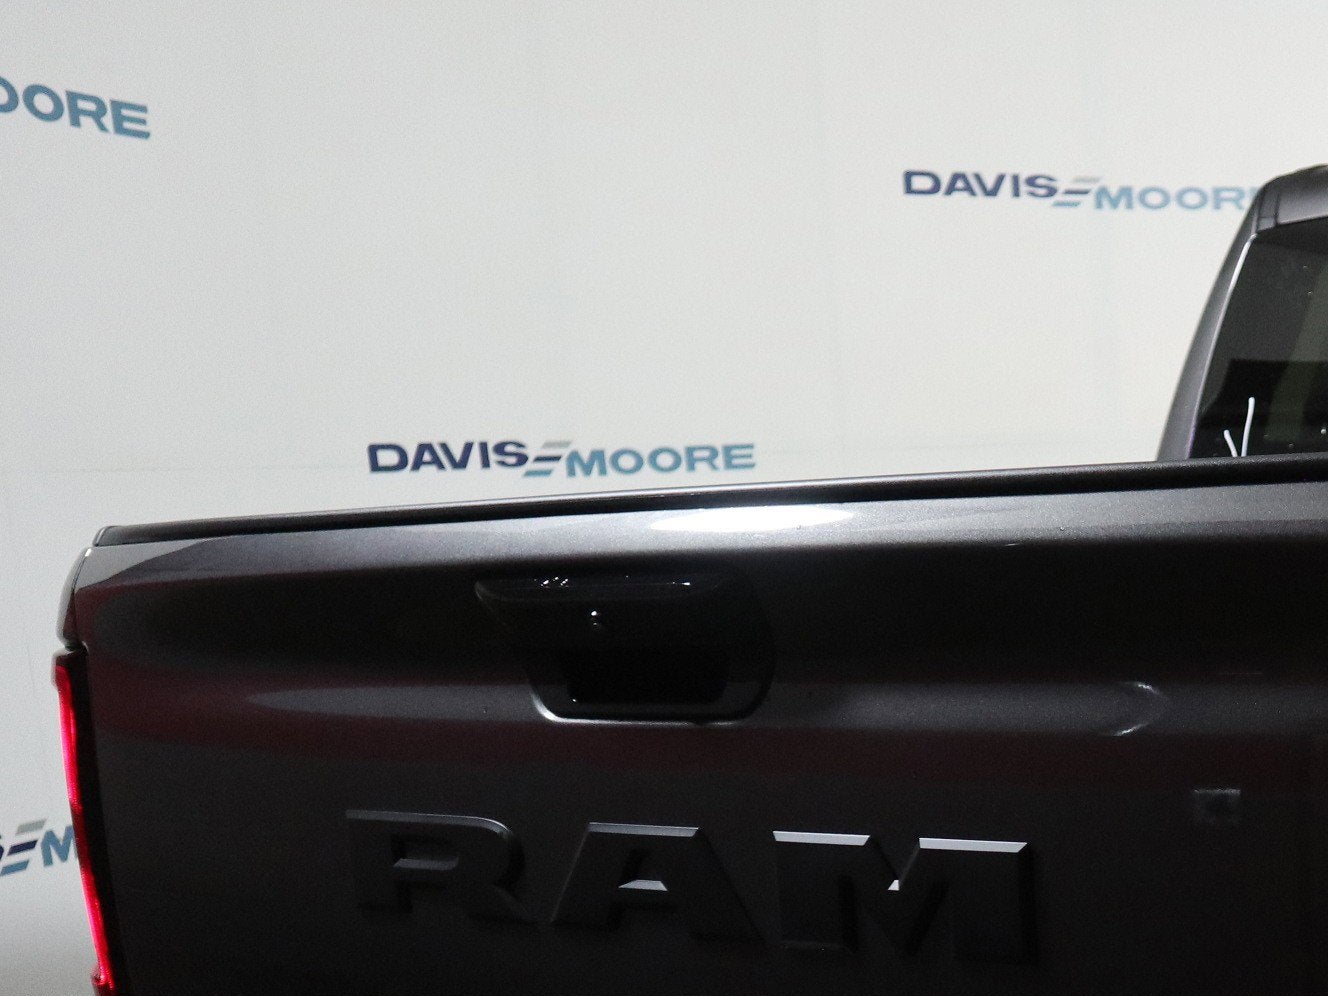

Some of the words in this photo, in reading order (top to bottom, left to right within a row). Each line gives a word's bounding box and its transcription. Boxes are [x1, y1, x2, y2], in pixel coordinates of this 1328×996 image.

[903, 170, 1057, 198] DAVIS
[1094, 186, 1258, 210] MOOR
[367, 440, 529, 474] DAVIS
[565, 443, 757, 478] MOORE
[345, 809, 1037, 963] RAM
